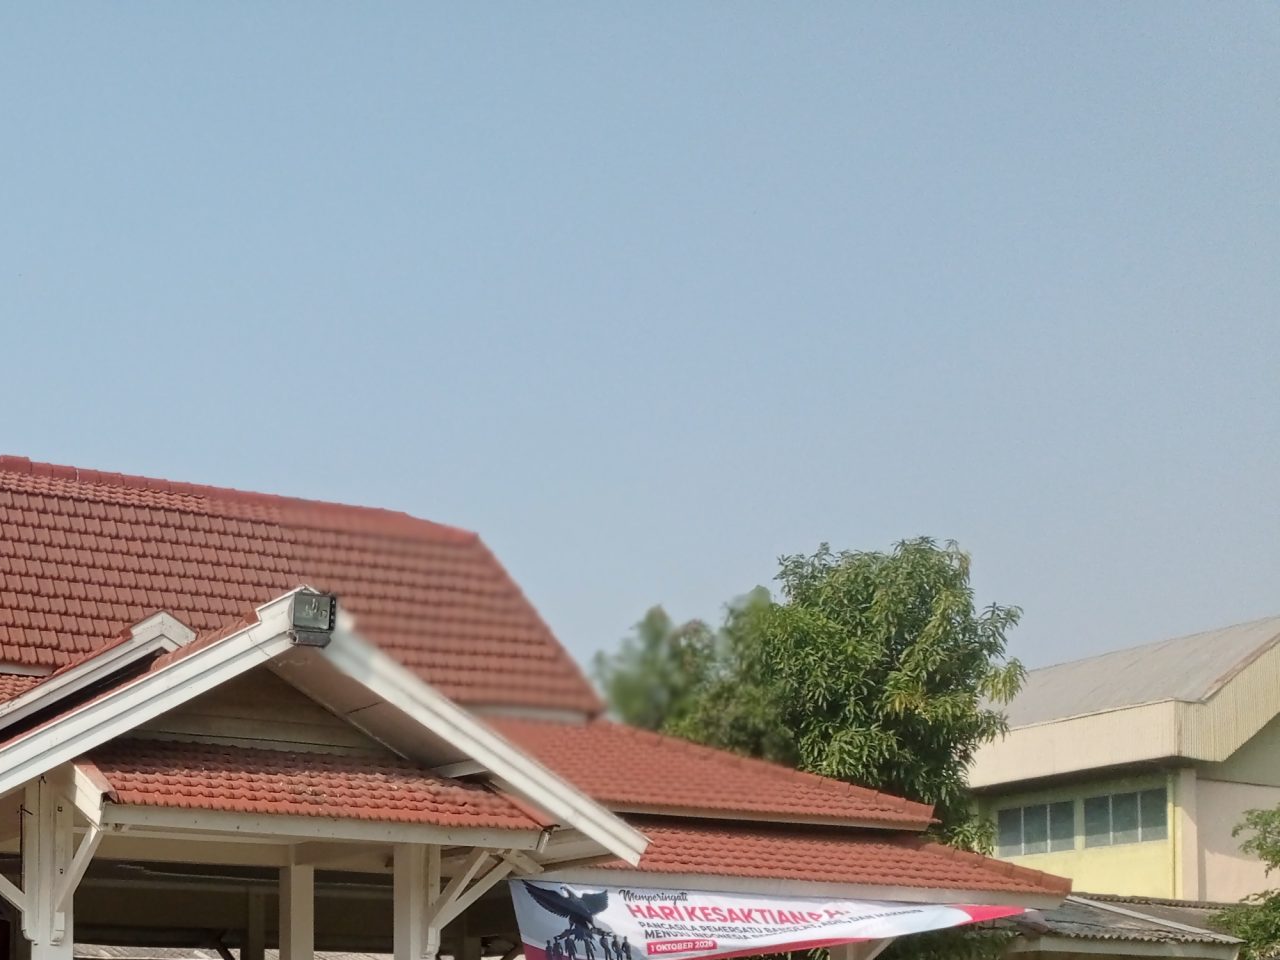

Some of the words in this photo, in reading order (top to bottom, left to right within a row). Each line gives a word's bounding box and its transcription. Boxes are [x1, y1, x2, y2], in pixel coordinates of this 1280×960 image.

[618, 889, 689, 906] Memperingati
[625, 903, 684, 921] HARI
[682, 905, 812, 926] KESAKTIAN
[850, 913, 876, 922] DAN
[638, 920, 700, 933] PANCASILA
[699, 925, 763, 934] PEMERSATU
[644, 929, 691, 940] MENUJU
[691, 932, 752, 941] INDONESIA
[655, 942, 694, 952] OKTOBER
